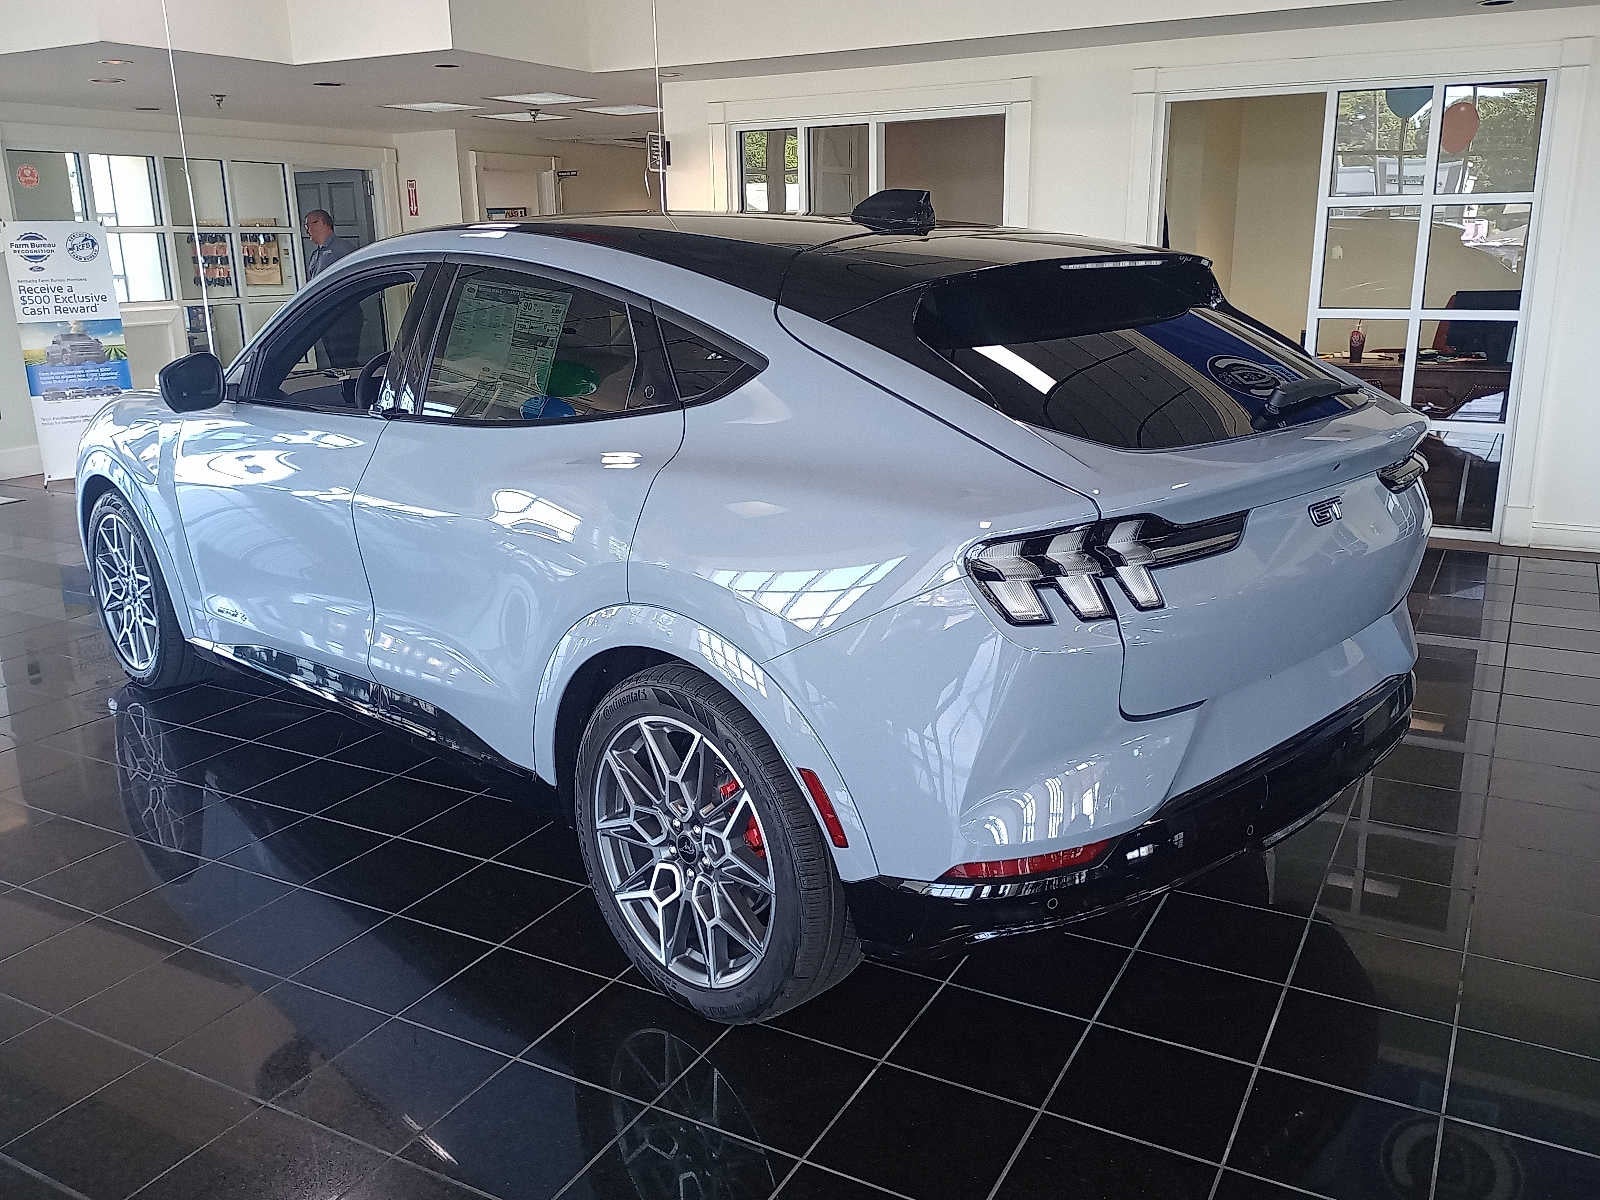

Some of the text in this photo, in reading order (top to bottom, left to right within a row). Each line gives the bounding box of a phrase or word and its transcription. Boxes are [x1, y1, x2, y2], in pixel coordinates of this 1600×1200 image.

[18, 284, 64, 295] Receive
[20, 293, 108, 306] $500 Exclusive
[22, 305, 51, 316] Cash
[1307, 496, 1343, 528] GT
[602, 689, 641, 720] Continental
